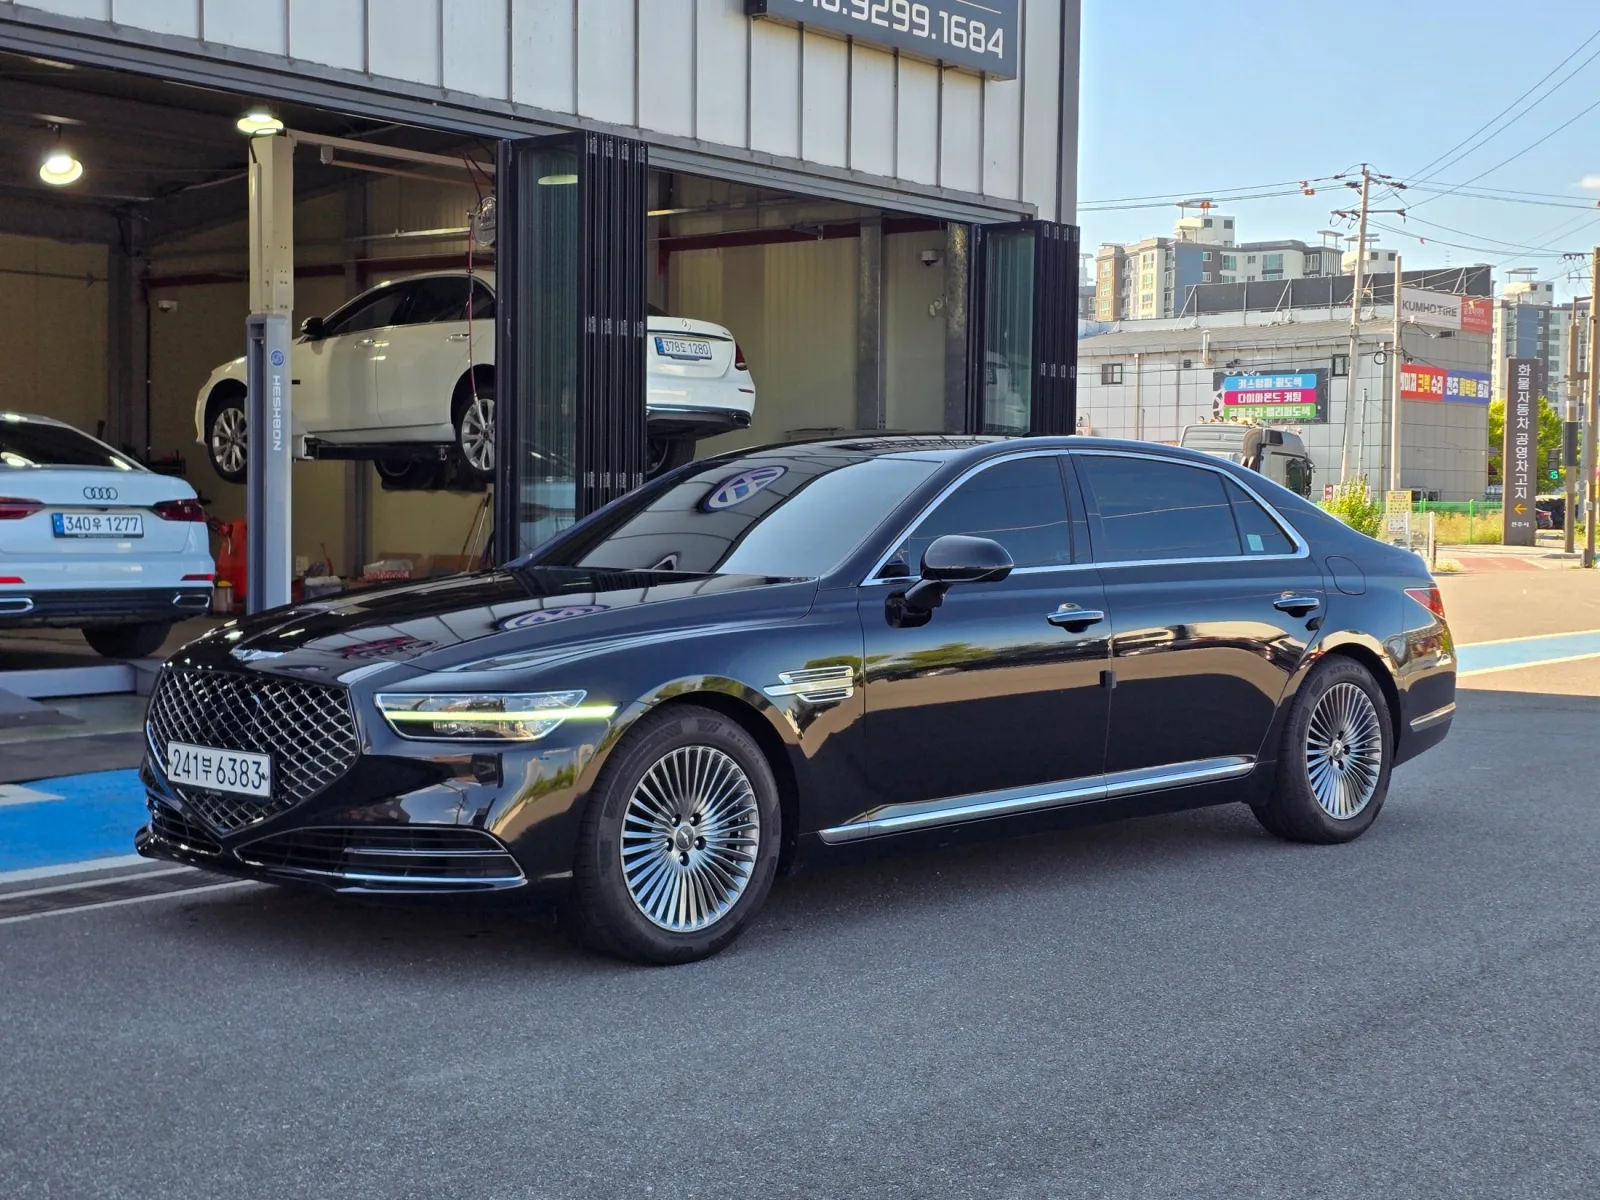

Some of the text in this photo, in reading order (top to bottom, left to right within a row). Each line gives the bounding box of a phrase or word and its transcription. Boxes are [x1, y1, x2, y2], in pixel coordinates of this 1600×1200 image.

[1402, 300, 1458, 317] KUMHO TIRE
[664, 340, 709, 355] 378도 1280
[1431, 375, 1444, 395] 수리
[1238, 391, 1302, 404] 다이아몬드 커팅
[272, 375, 282, 451] HESHBON
[1514, 364, 1531, 500] 화물자동차 공영차고지
[65, 516, 139, 532] 340우 1277
[1329, 664, 1363, 676] NEXEN
